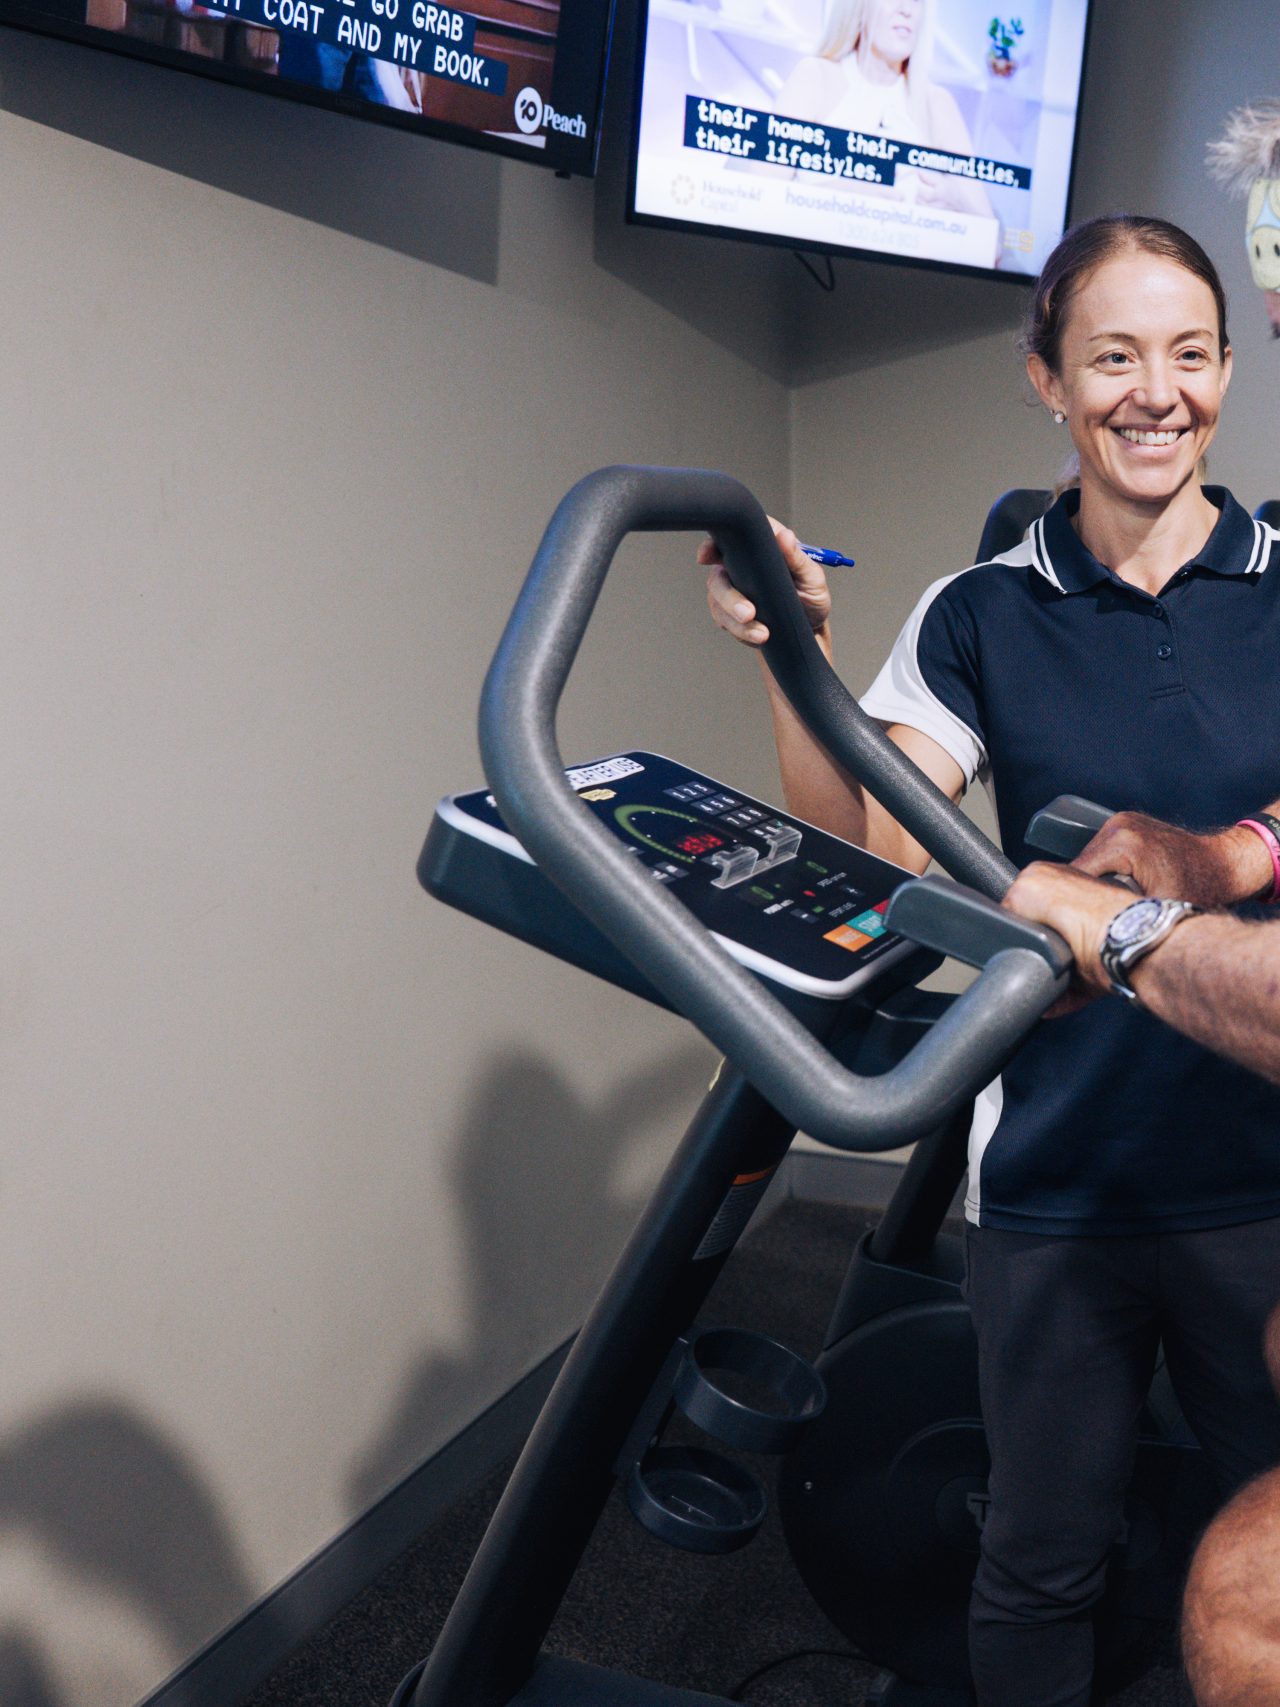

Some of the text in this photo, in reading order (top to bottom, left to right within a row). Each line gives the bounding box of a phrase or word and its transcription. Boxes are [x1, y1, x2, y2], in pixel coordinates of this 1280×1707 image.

[263, 0, 490, 87] COAT AND MY BOOK.
[412, 2, 464, 42] GRAB
[542, 104, 587, 138] Peach
[697, 99, 1020, 189] their homes, their communities,
[695, 126, 882, 183] their lifestyles.
[784, 186, 968, 236] householdcapital.com.au
